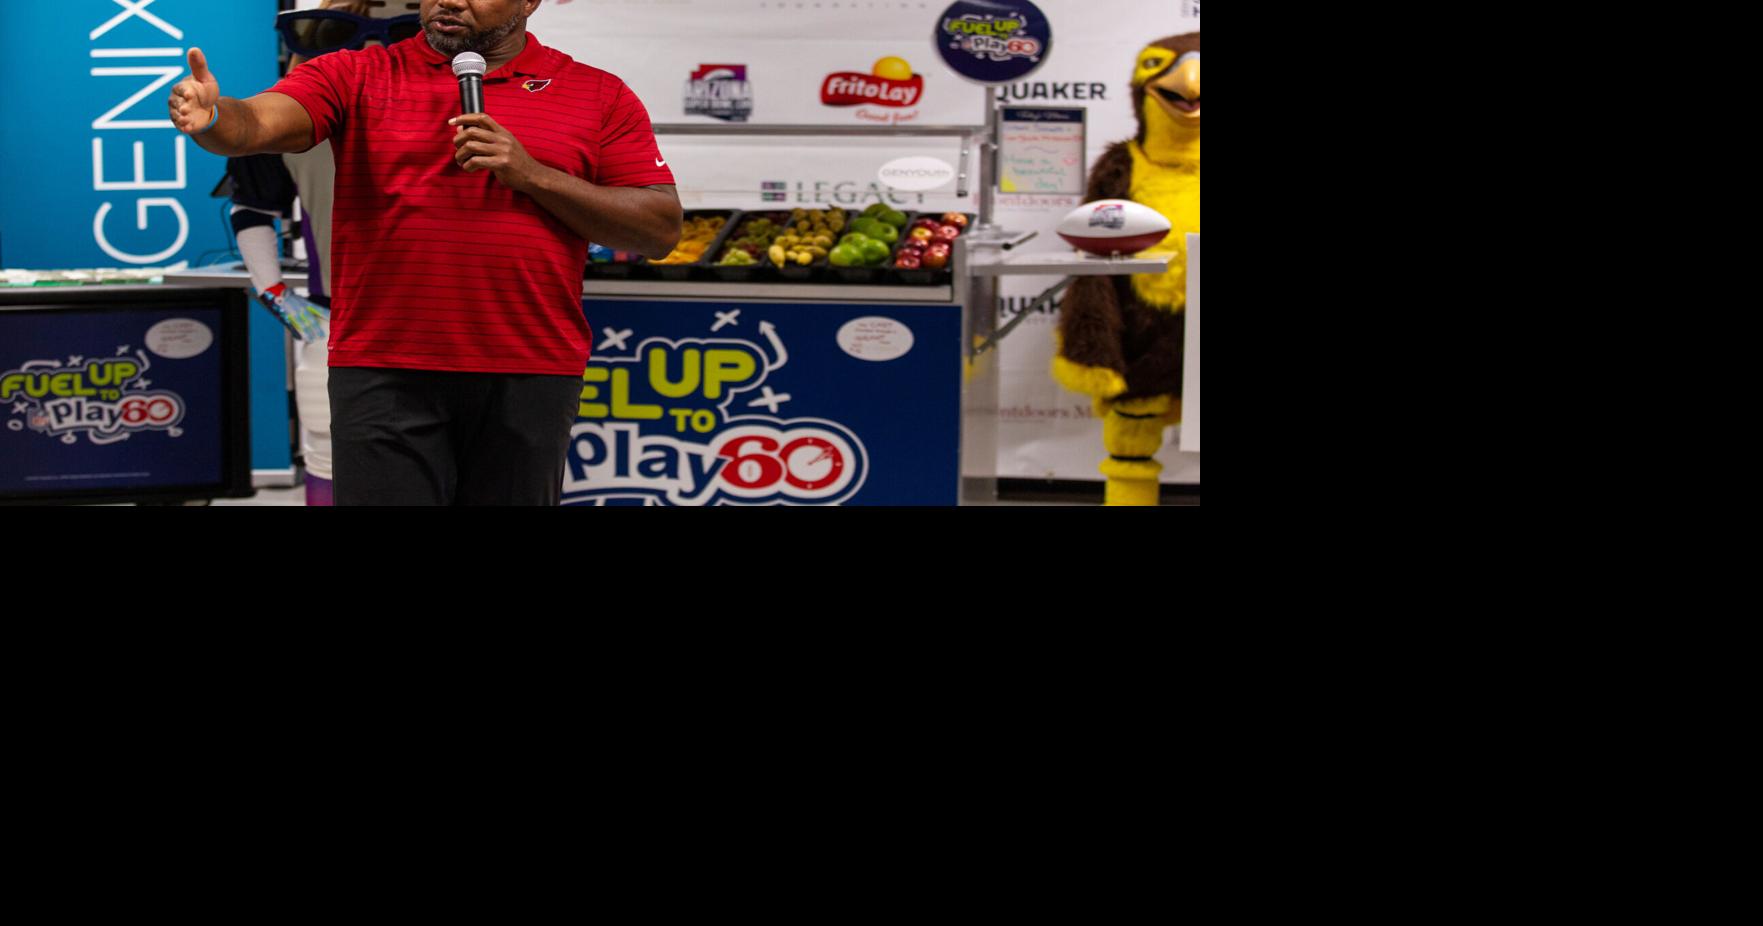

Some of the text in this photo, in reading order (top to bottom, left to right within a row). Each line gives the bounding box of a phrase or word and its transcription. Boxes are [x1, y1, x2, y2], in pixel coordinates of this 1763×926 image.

[949, 19, 1019, 35] FUEL UP
[90, 0, 189, 270] GENIX
[1, 362, 138, 398] FUEL UP
[648, 347, 757, 399] UP
[99, 389, 120, 400] TO
[121, 399, 174, 424] 60
[669, 408, 716, 433] TO
[719, 435, 844, 490] 60
